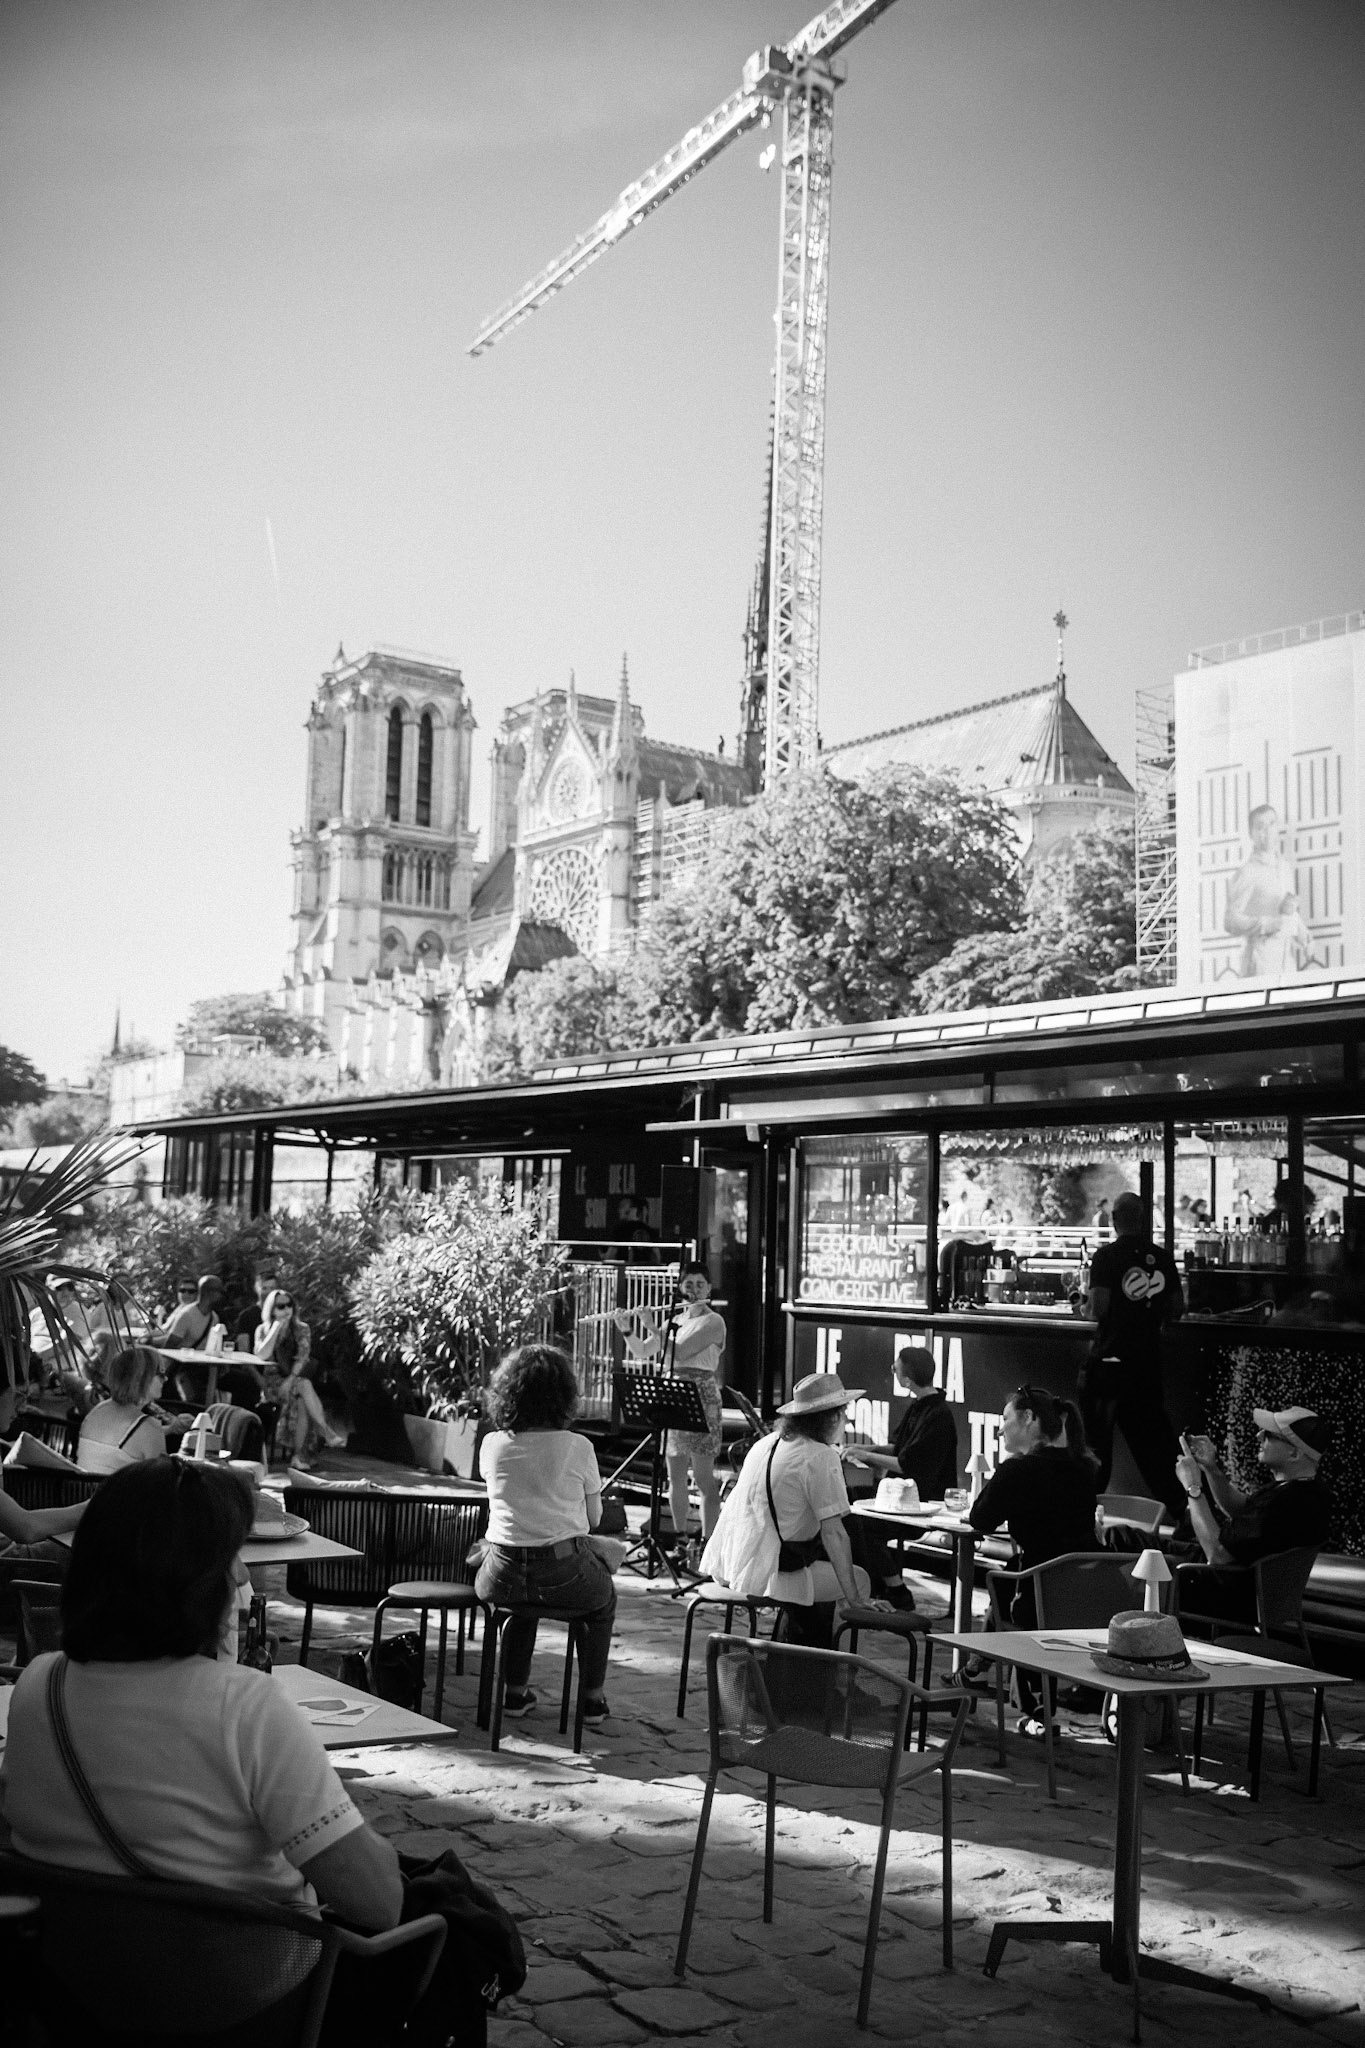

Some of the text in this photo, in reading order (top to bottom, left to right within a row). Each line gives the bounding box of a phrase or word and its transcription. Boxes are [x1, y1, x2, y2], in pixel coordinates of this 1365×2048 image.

[819, 1234, 900, 1256] COCKTAILS
[808, 1254, 904, 1279] RESTAURANT
[800, 1278, 915, 1303] CONCERTS LIVE
